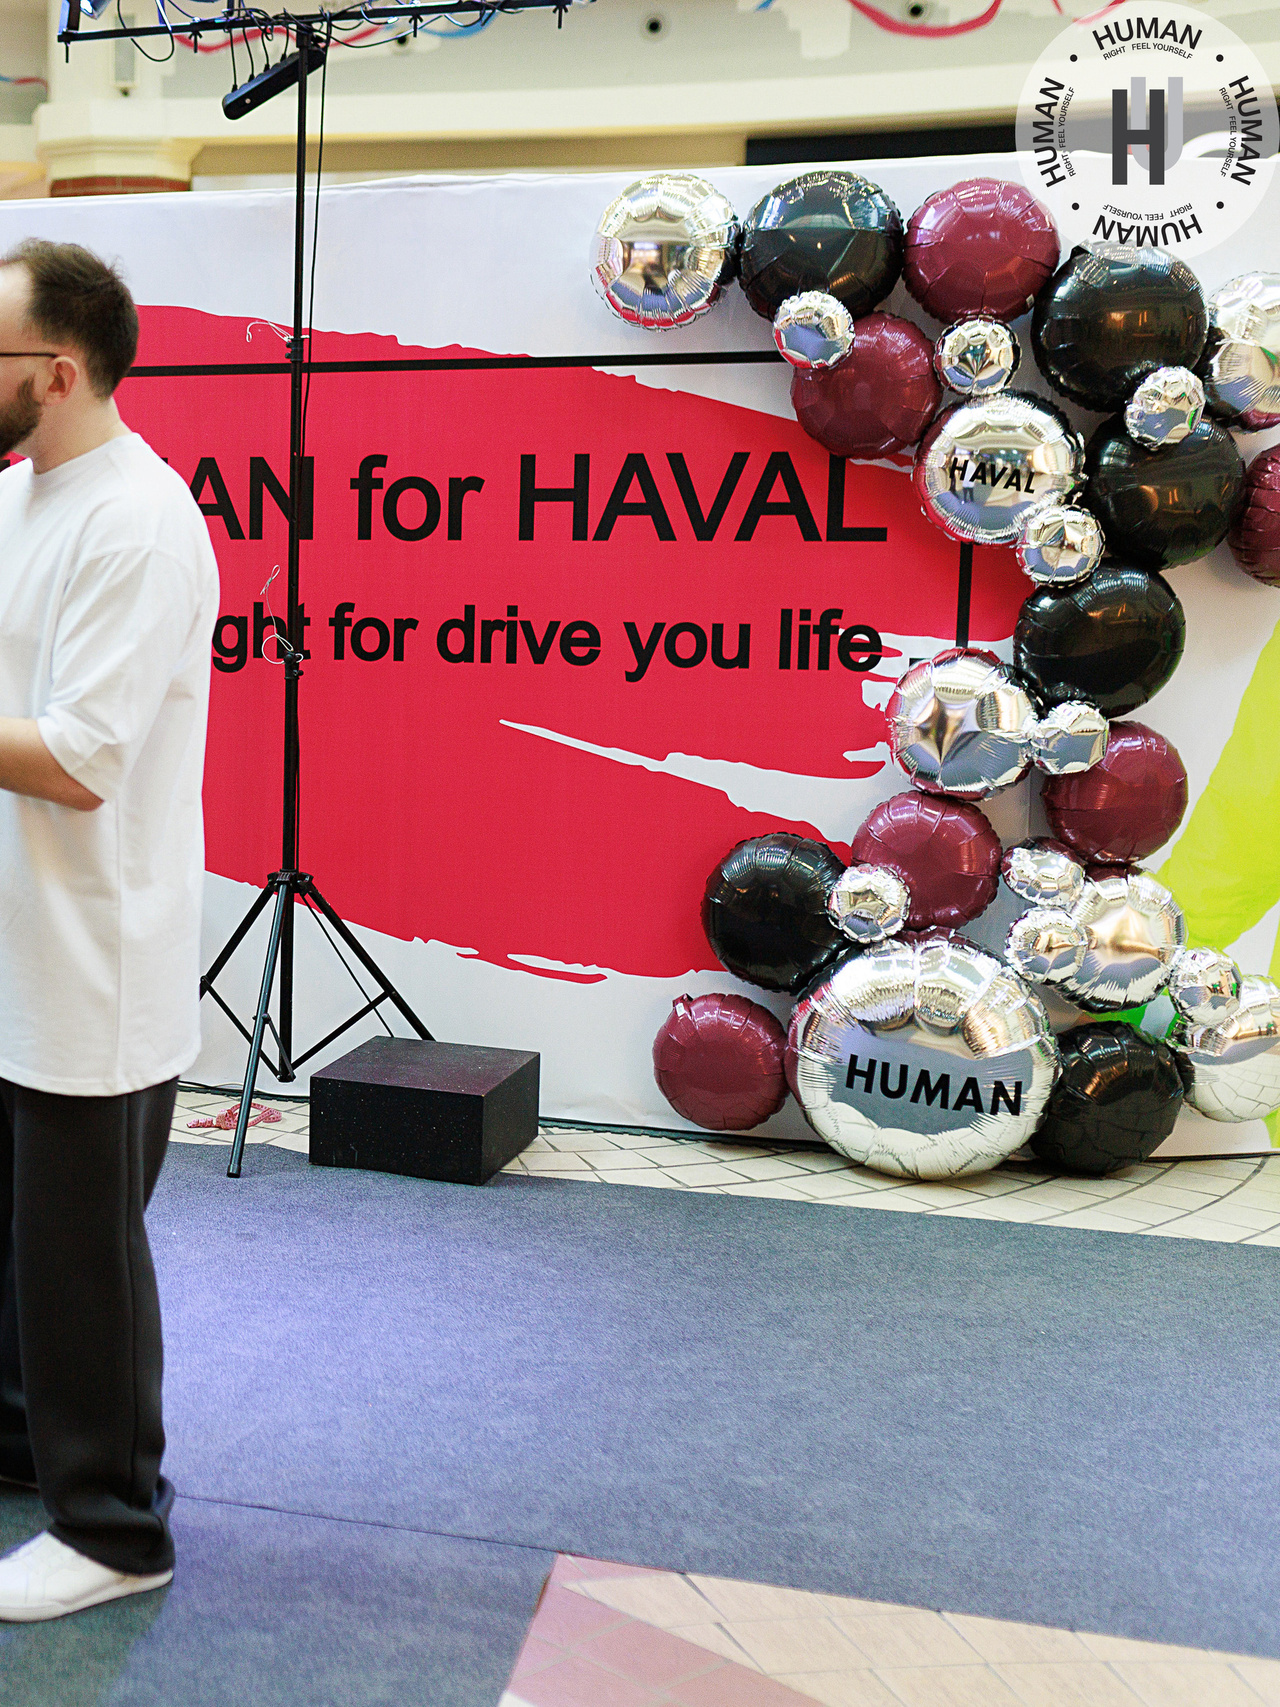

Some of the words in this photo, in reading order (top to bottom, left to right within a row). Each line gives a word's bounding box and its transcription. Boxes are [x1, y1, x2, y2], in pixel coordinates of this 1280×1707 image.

[351, 455, 484, 543] for
[521, 451, 888, 542] HAVAL
[949, 456, 1038, 494] HAVAL
[211, 601, 312, 674] ght
[328, 602, 420, 662] for
[437, 603, 602, 668] drive
[625, 618, 758, 684] you
[777, 607, 883, 673] life
[845, 1054, 1023, 1116] HUMAN
